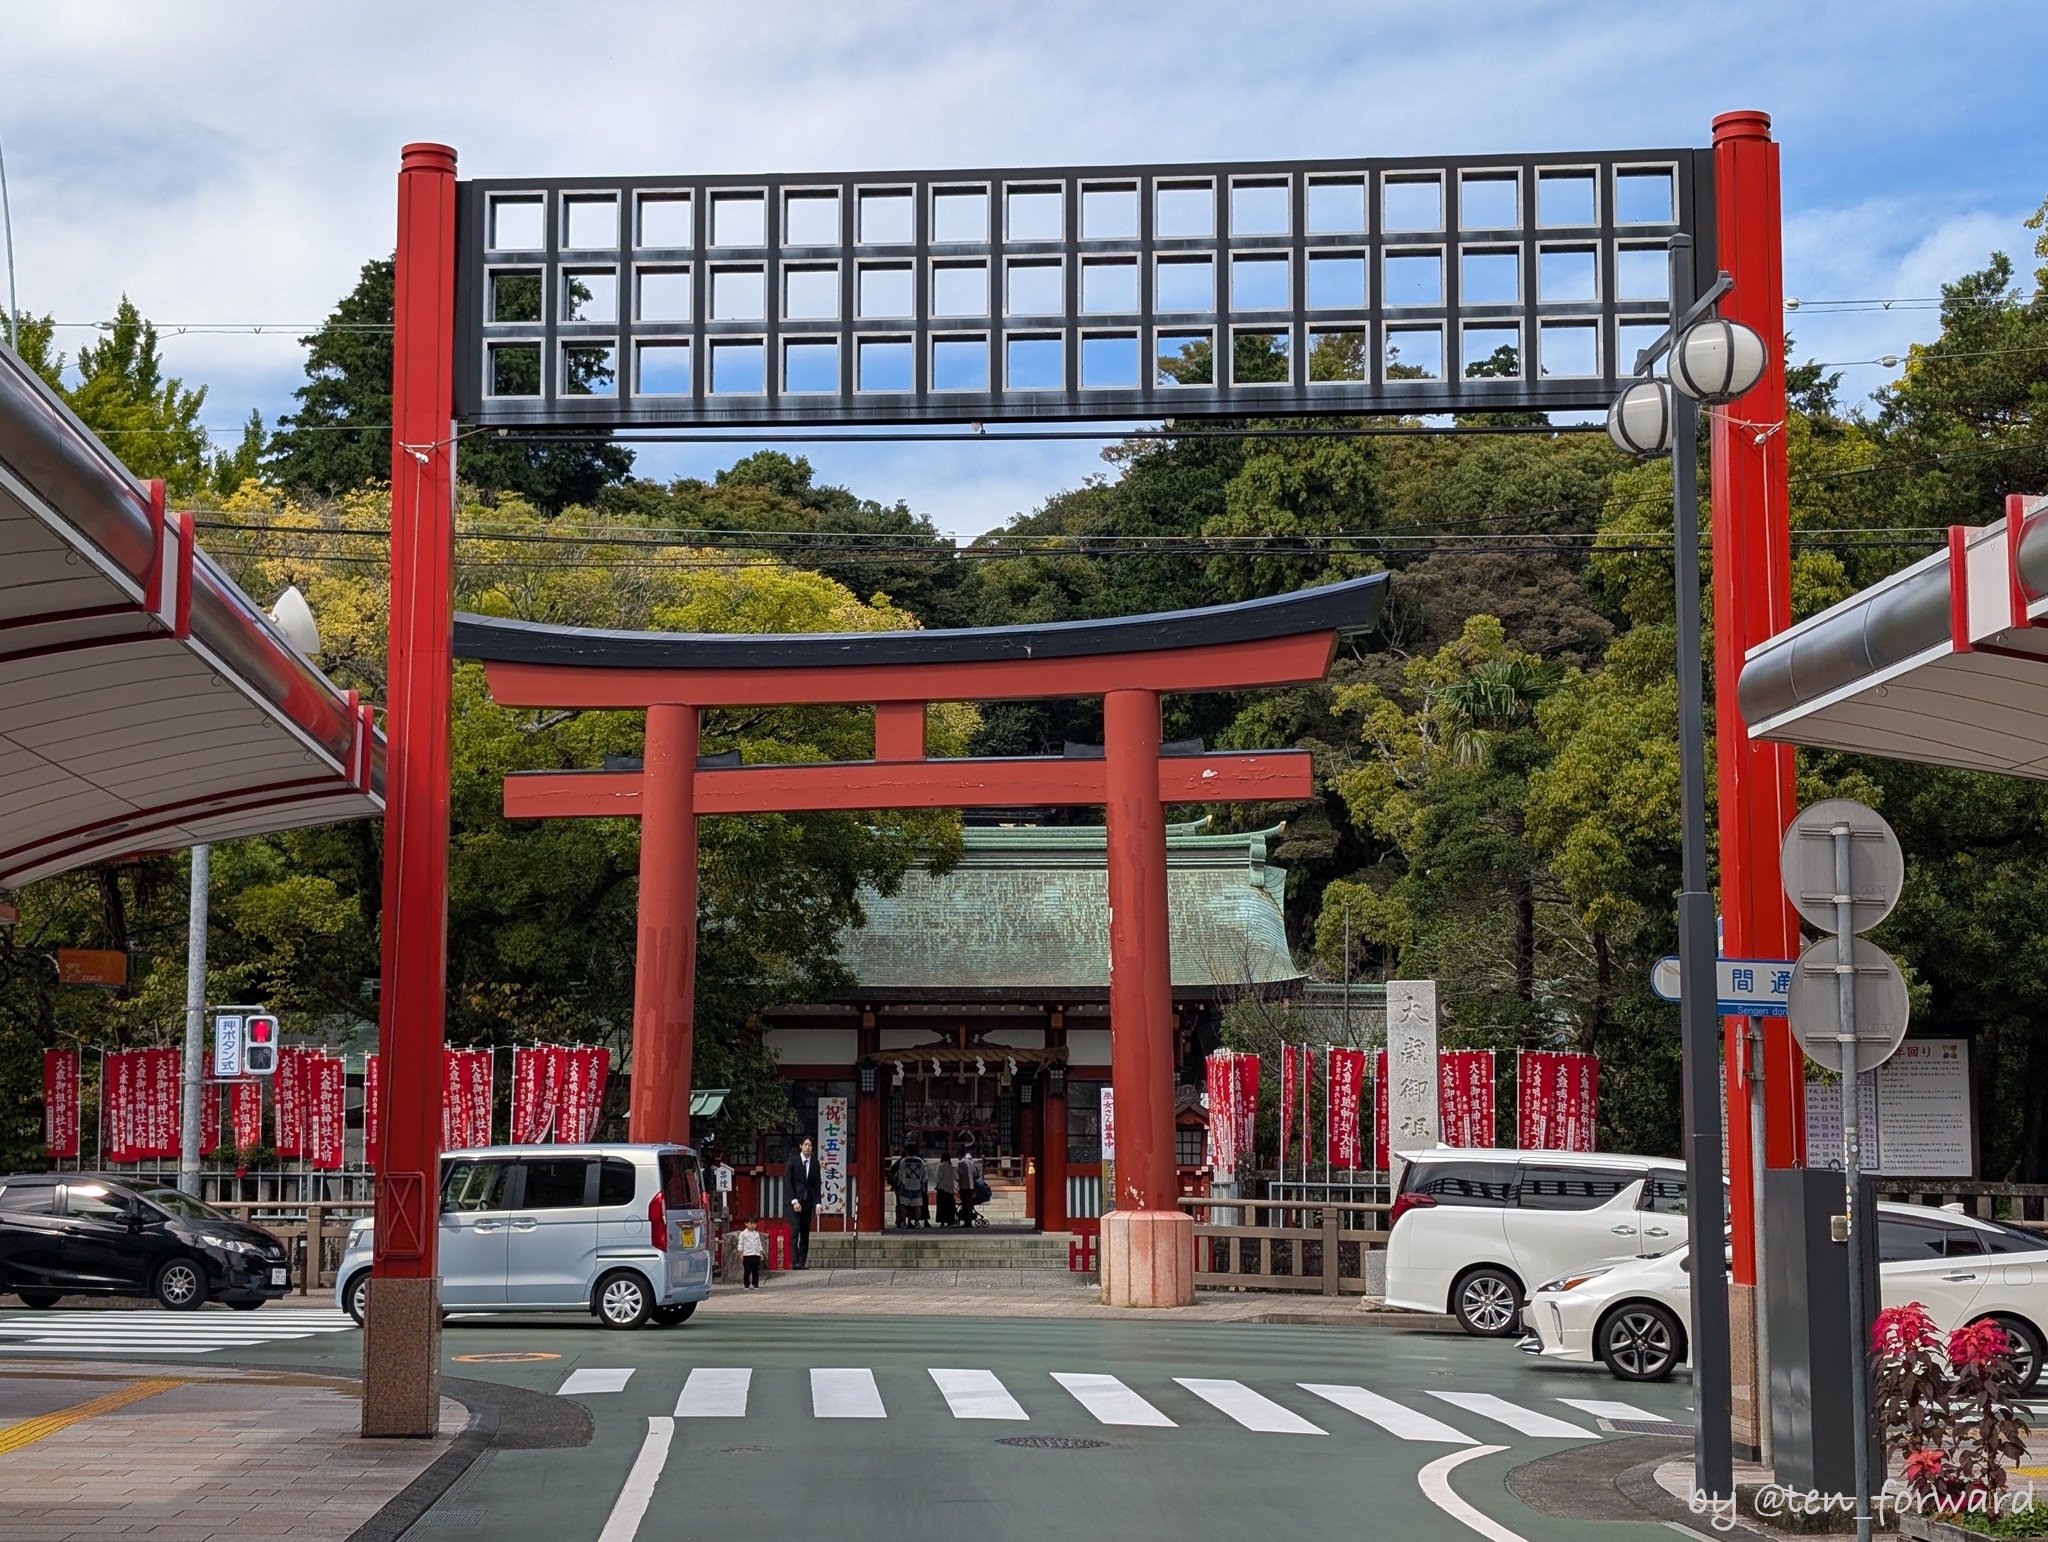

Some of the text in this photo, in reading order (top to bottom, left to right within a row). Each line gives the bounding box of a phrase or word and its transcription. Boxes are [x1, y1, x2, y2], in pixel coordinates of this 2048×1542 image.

[222, 1021, 236, 1071] 押ボタン式
[1737, 1006, 1768, 1017] Sengen
[156, 1057, 168, 1150] 大歳御祖神社大前
[281, 1055, 294, 1149] 大歳御祖神社大前
[320, 1069, 333, 1162] 大歳御祖神社大前
[719, 1170, 728, 1188] 禁煙
